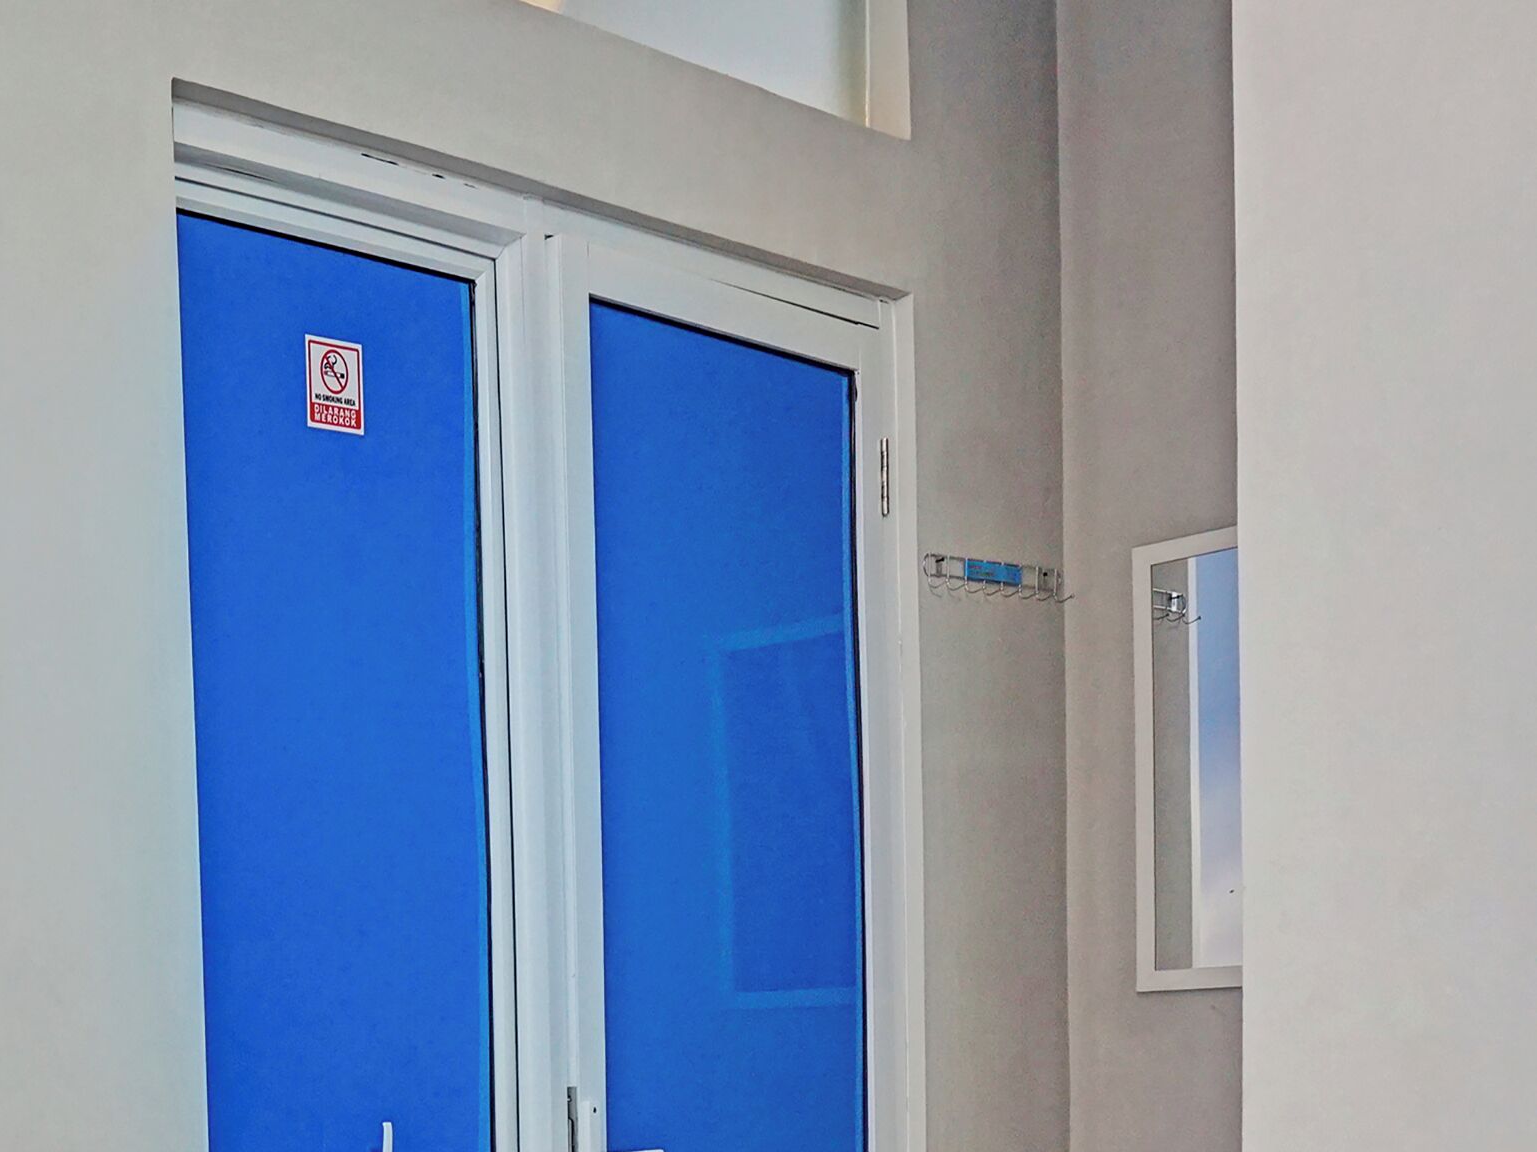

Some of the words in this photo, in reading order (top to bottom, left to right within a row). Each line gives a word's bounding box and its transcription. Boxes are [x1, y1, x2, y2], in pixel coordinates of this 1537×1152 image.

[322, 394, 343, 404] SMOKING
[344, 397, 356, 406] AREA
[314, 404, 357, 418] DILARANG
[314, 413, 357, 427] MEROKOK
